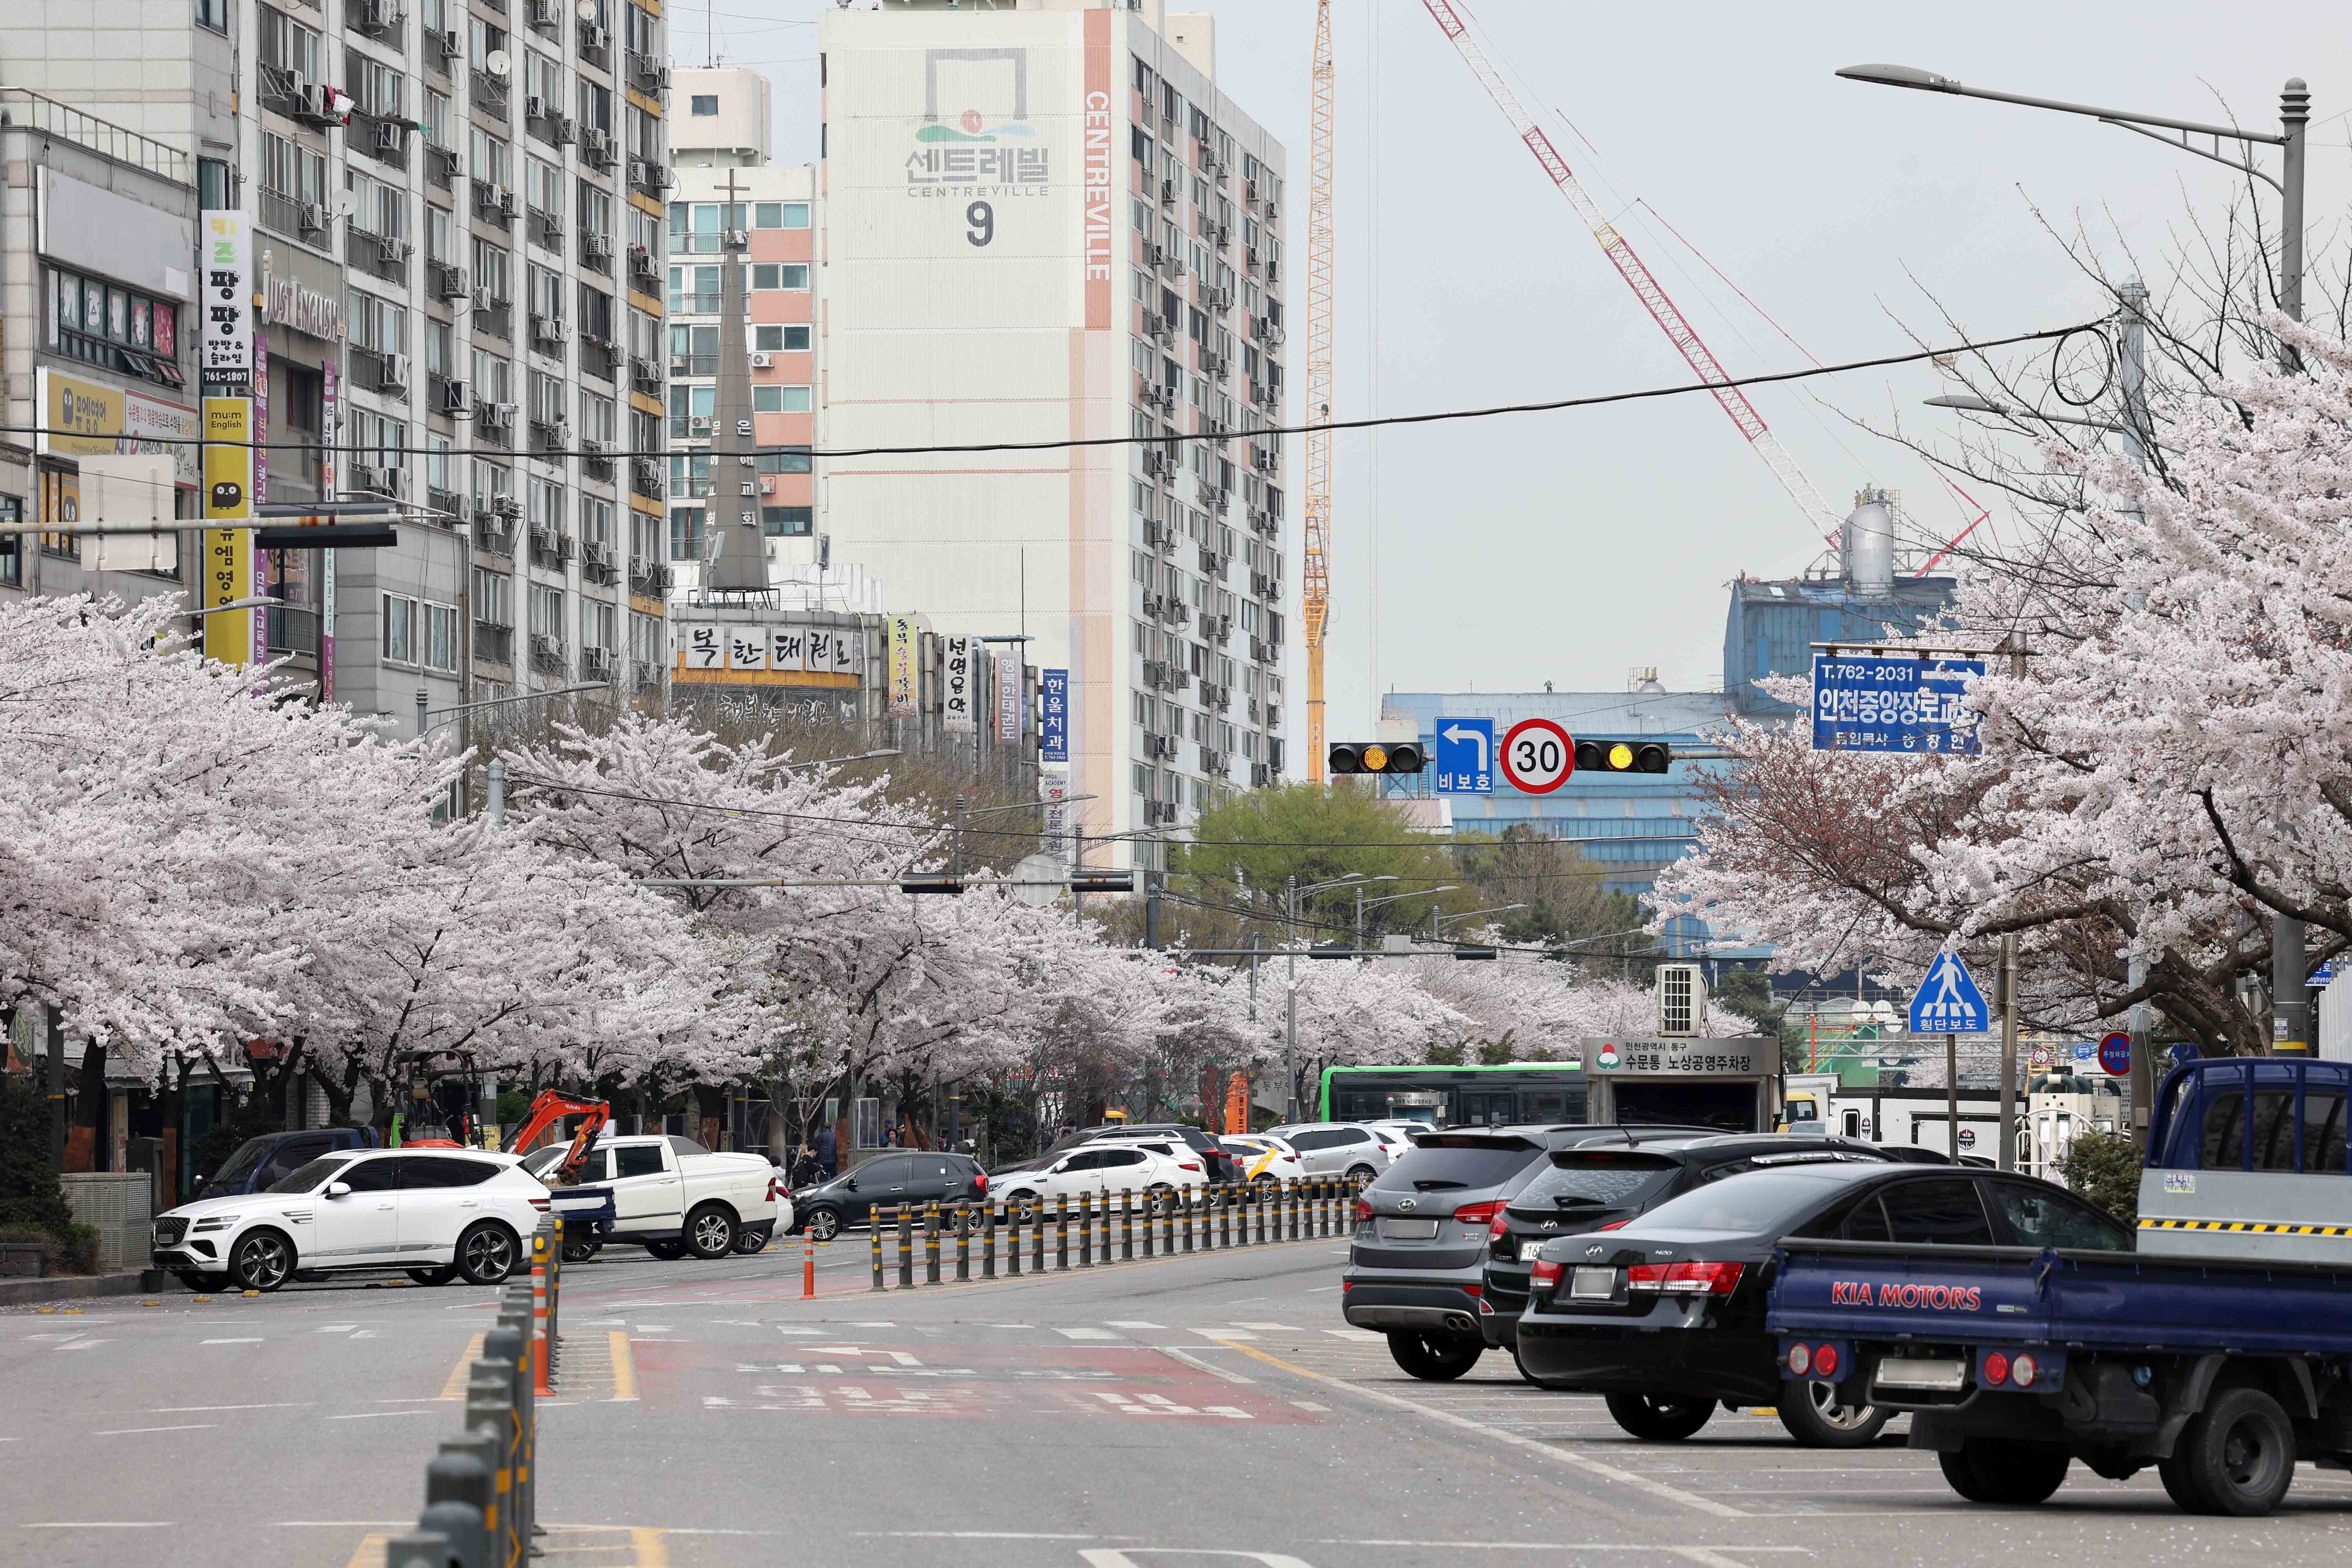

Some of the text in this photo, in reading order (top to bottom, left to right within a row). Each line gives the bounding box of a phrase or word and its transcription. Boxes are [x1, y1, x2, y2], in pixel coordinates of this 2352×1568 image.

[904, 148, 1048, 183] 센트레빌
[908, 187, 1049, 197] CENTREVILLE
[1087, 91, 1110, 282] CENTREVILLE
[966, 201, 993, 247] 9
[208, 340, 243, 350] 방방 &
[211, 352, 241, 365] 슬라임
[205, 372, 247, 382] 761-1807
[211, 411, 241, 419] mu:m
[211, 421, 241, 430] English
[691, 628, 850, 668] 복한태권도
[1046, 679, 1064, 750] 한울치과
[1516, 741, 1559, 772] 30
[1439, 771, 1491, 791] 비보호
[1920, 1019, 1978, 1031] 횡단보도
[1625, 1042, 1688, 1051] 인천광역시 동구
[1626, 1055, 1751, 1072] 수문통 노상공영주차장
[1832, 1281, 1981, 1312] KIA MOTORS
